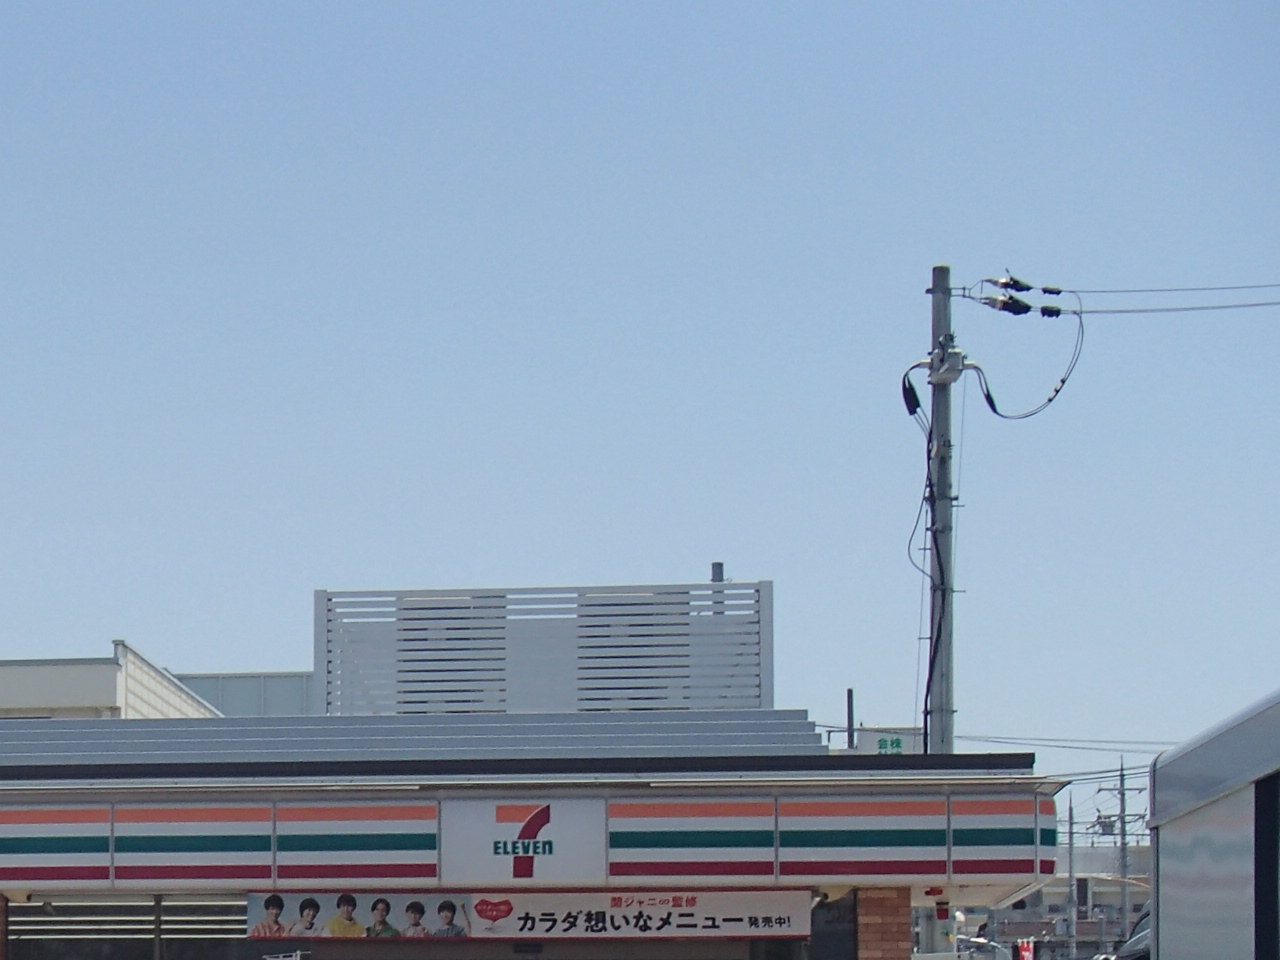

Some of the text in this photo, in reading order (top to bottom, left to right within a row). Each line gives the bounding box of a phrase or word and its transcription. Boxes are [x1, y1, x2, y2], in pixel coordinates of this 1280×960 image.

[517, 911, 744, 933] カラダ想いなメニュー
